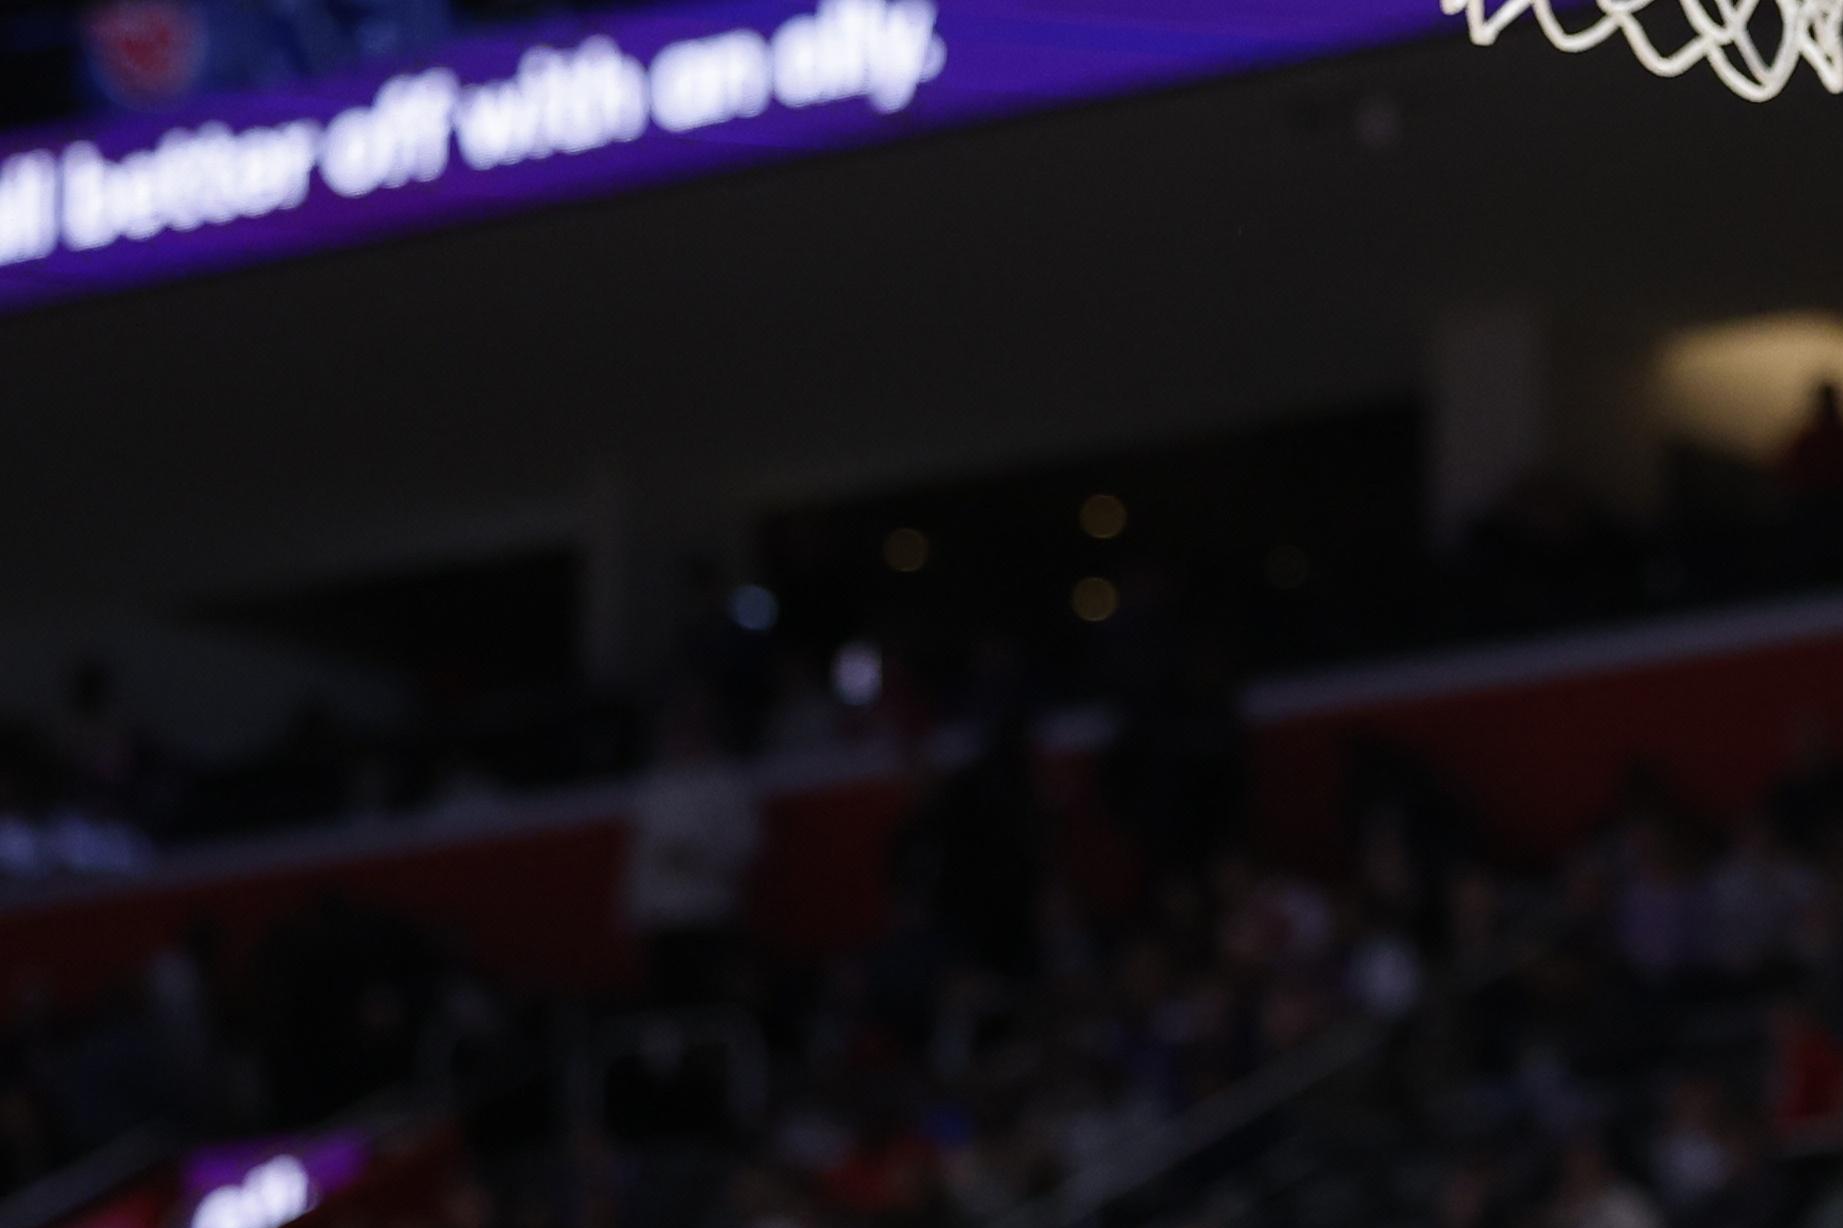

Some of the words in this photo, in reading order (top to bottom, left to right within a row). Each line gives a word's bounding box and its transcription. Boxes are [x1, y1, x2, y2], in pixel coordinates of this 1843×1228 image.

[0, 150, 58, 266] ll
[62, 120, 316, 250] better
[320, 66, 458, 196] off
[455, 34, 650, 170] with
[648, 28, 770, 132] an
